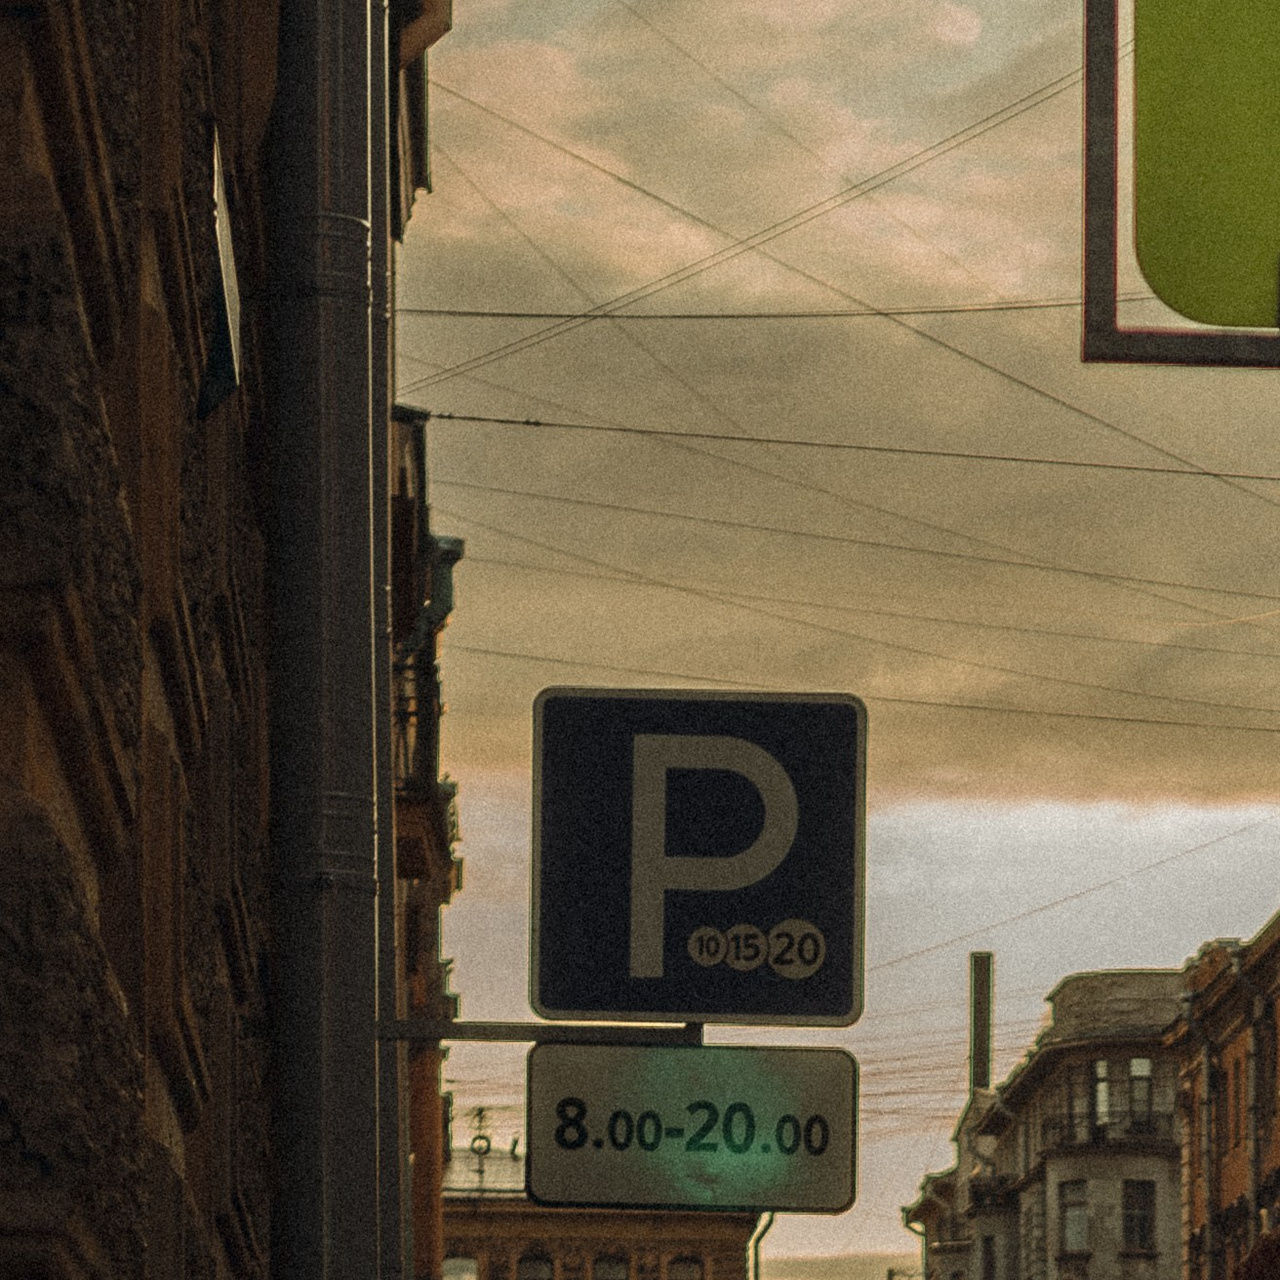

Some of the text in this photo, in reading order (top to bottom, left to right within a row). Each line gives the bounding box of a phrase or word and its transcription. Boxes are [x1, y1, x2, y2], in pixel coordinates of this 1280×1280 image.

[630, 733, 799, 978] P
[695, 932, 820, 966] 10 15 20
[554, 1096, 830, 1156] 8.00-20.00
